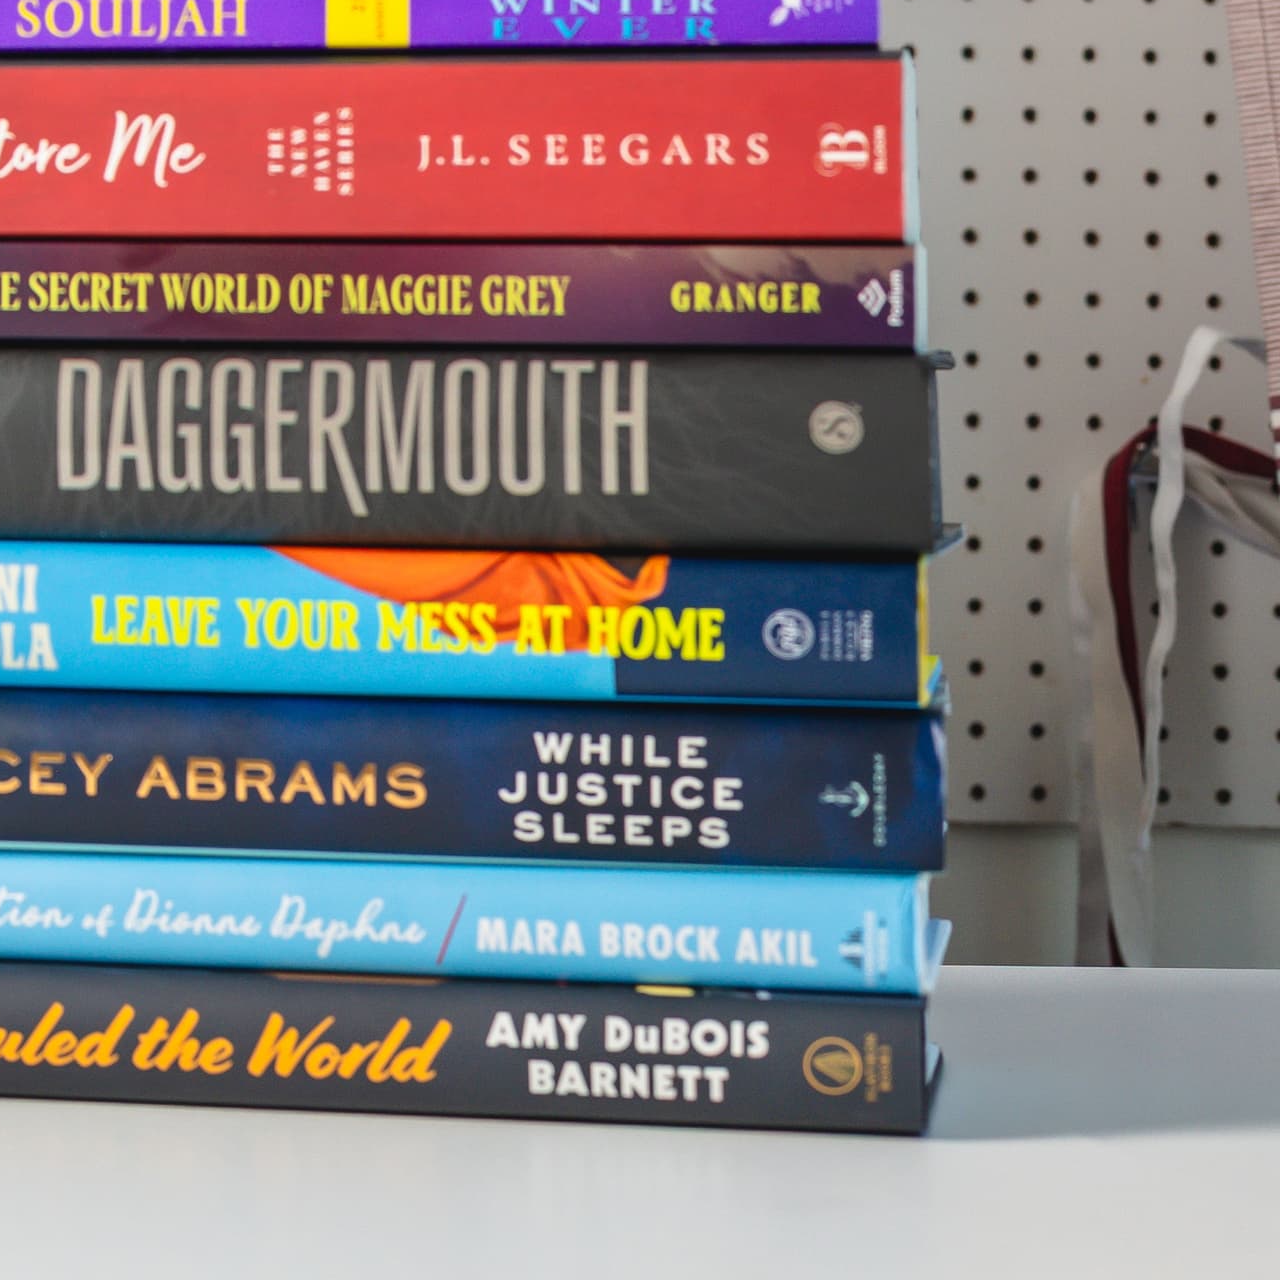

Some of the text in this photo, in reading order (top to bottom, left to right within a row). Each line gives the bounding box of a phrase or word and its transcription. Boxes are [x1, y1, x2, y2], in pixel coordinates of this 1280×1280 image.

[490, 16, 717, 41] EVER
[103, 110, 206, 188] Me
[266, 127, 286, 177] THE
[289, 124, 308, 178] NEW
[312, 111, 332, 192] HAVEN
[336, 106, 355, 197] SERIES
[417, 131, 770, 172] J.L. SEEGARS
[28, 271, 154, 313] SECRET
[160, 272, 281, 314] WORLD
[288, 273, 335, 315] OF
[340, 273, 474, 316] MAGGIE
[480, 274, 571, 316] GREY
[669, 280, 822, 314] GRANGER
[887, 268, 904, 327] Podium
[56, 357, 649, 517] DAGGERMOUTH
[90, 594, 220, 648] LEAVE
[236, 597, 359, 652] YOUR
[376, 600, 497, 655] MESS
[513, 604, 571, 656] AT
[587, 607, 725, 661] HOME
[532, 732, 708, 769] WHILE
[135, 754, 428, 809] ABRAMS
[497, 771, 744, 810] JUSTICE
[512, 811, 731, 849] SLEEPS
[81, 903, 114, 938] of
[123, 887, 262, 937] Dionne
[269, 893, 426, 959] Daphne
[476, 916, 585, 958] MARA
[599, 922, 720, 963] BROCK
[735, 928, 817, 968] AKIL
[132, 1007, 235, 1076] the
[245, 1011, 453, 1084] World
[485, 1011, 770, 1059] AMY DuBOIS
[527, 1058, 730, 1103] BARNETT
